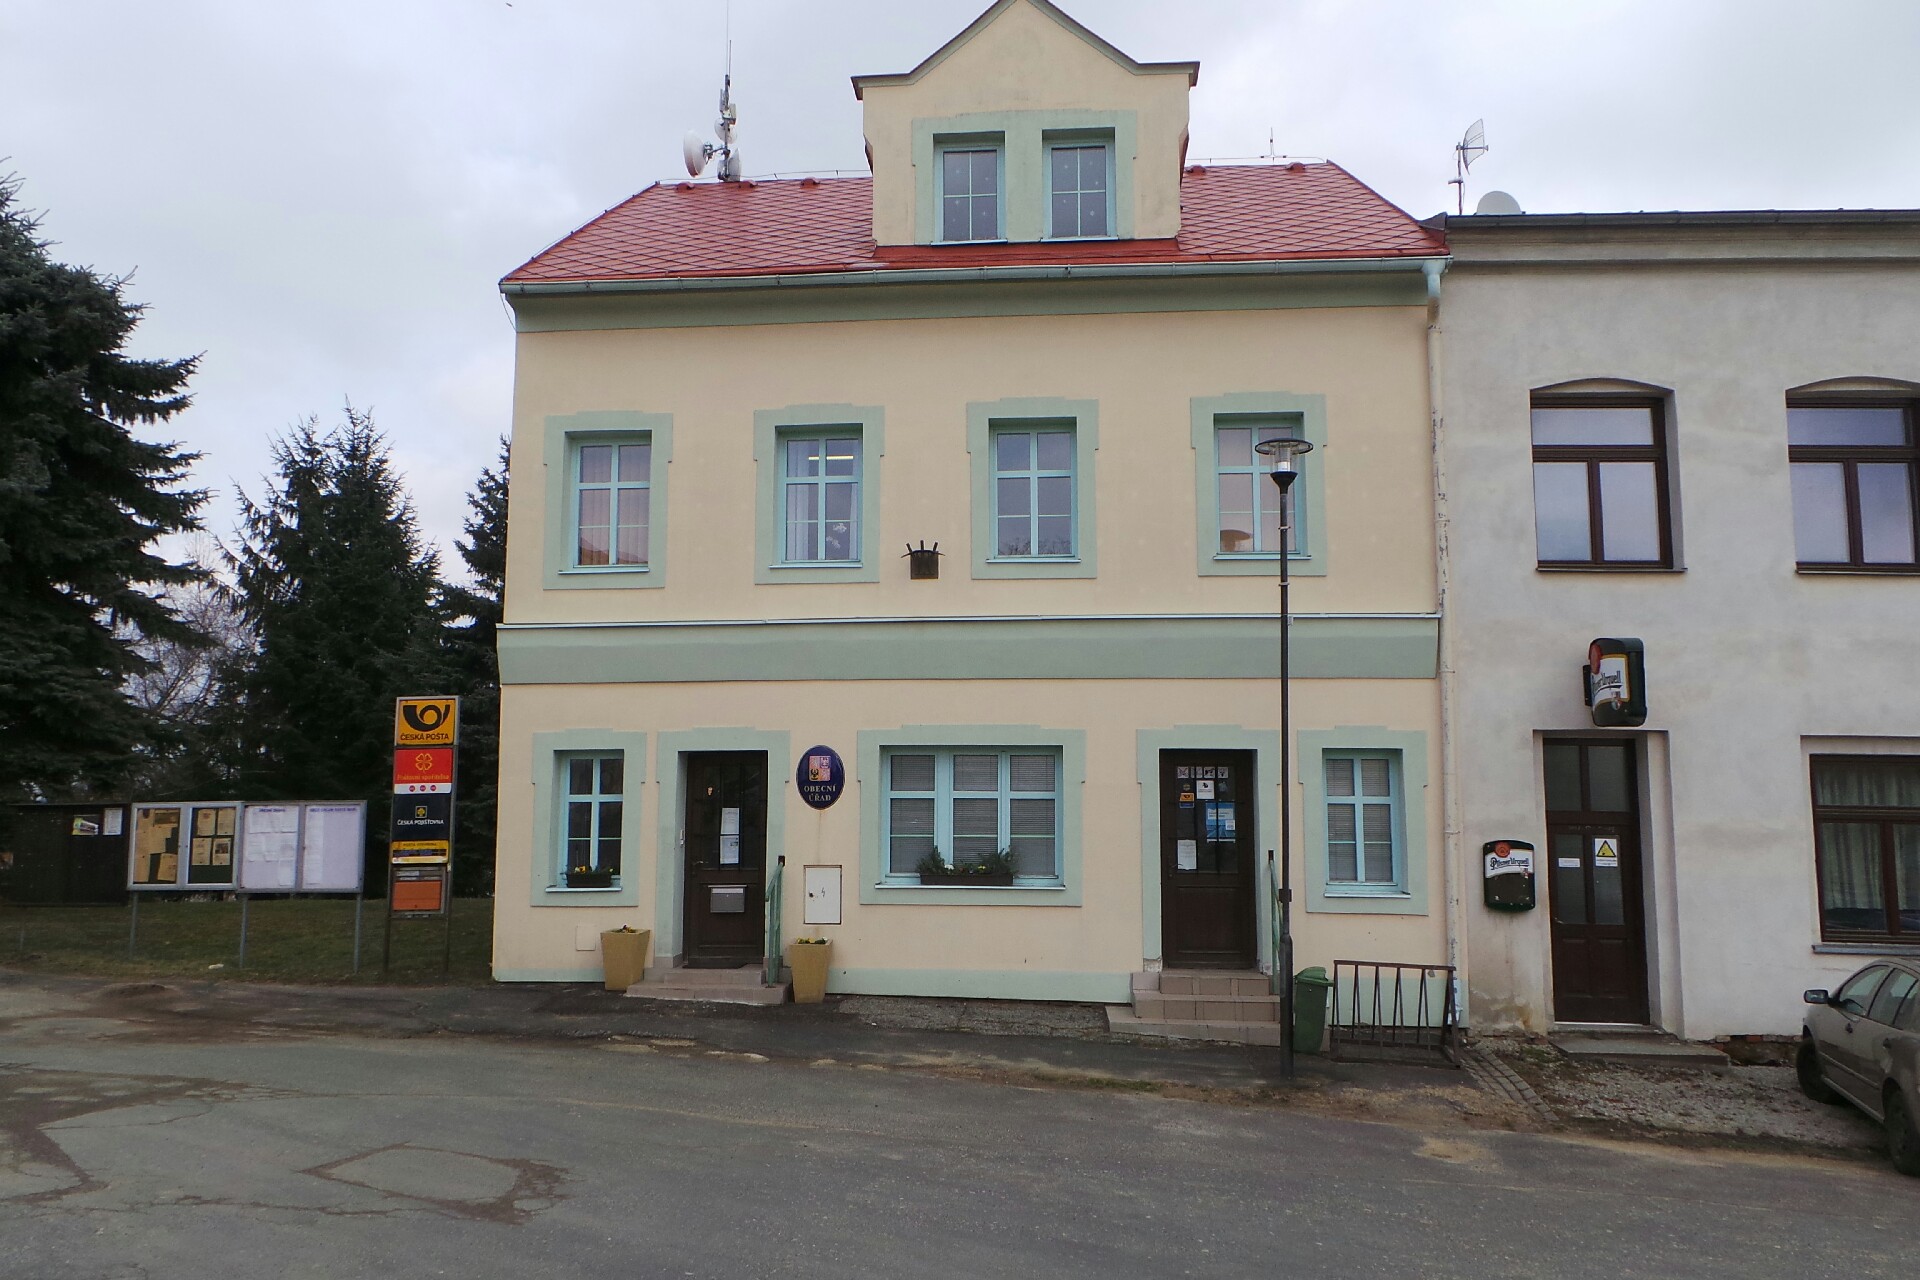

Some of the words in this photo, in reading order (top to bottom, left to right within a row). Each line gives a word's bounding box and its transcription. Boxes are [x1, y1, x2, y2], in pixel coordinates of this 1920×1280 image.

[400, 732, 425, 741] ČESKÁ
[426, 732, 449, 741] POŠTA
[803, 784, 836, 793] OBECNÍ
[808, 793, 831, 802] ÚŘAD
